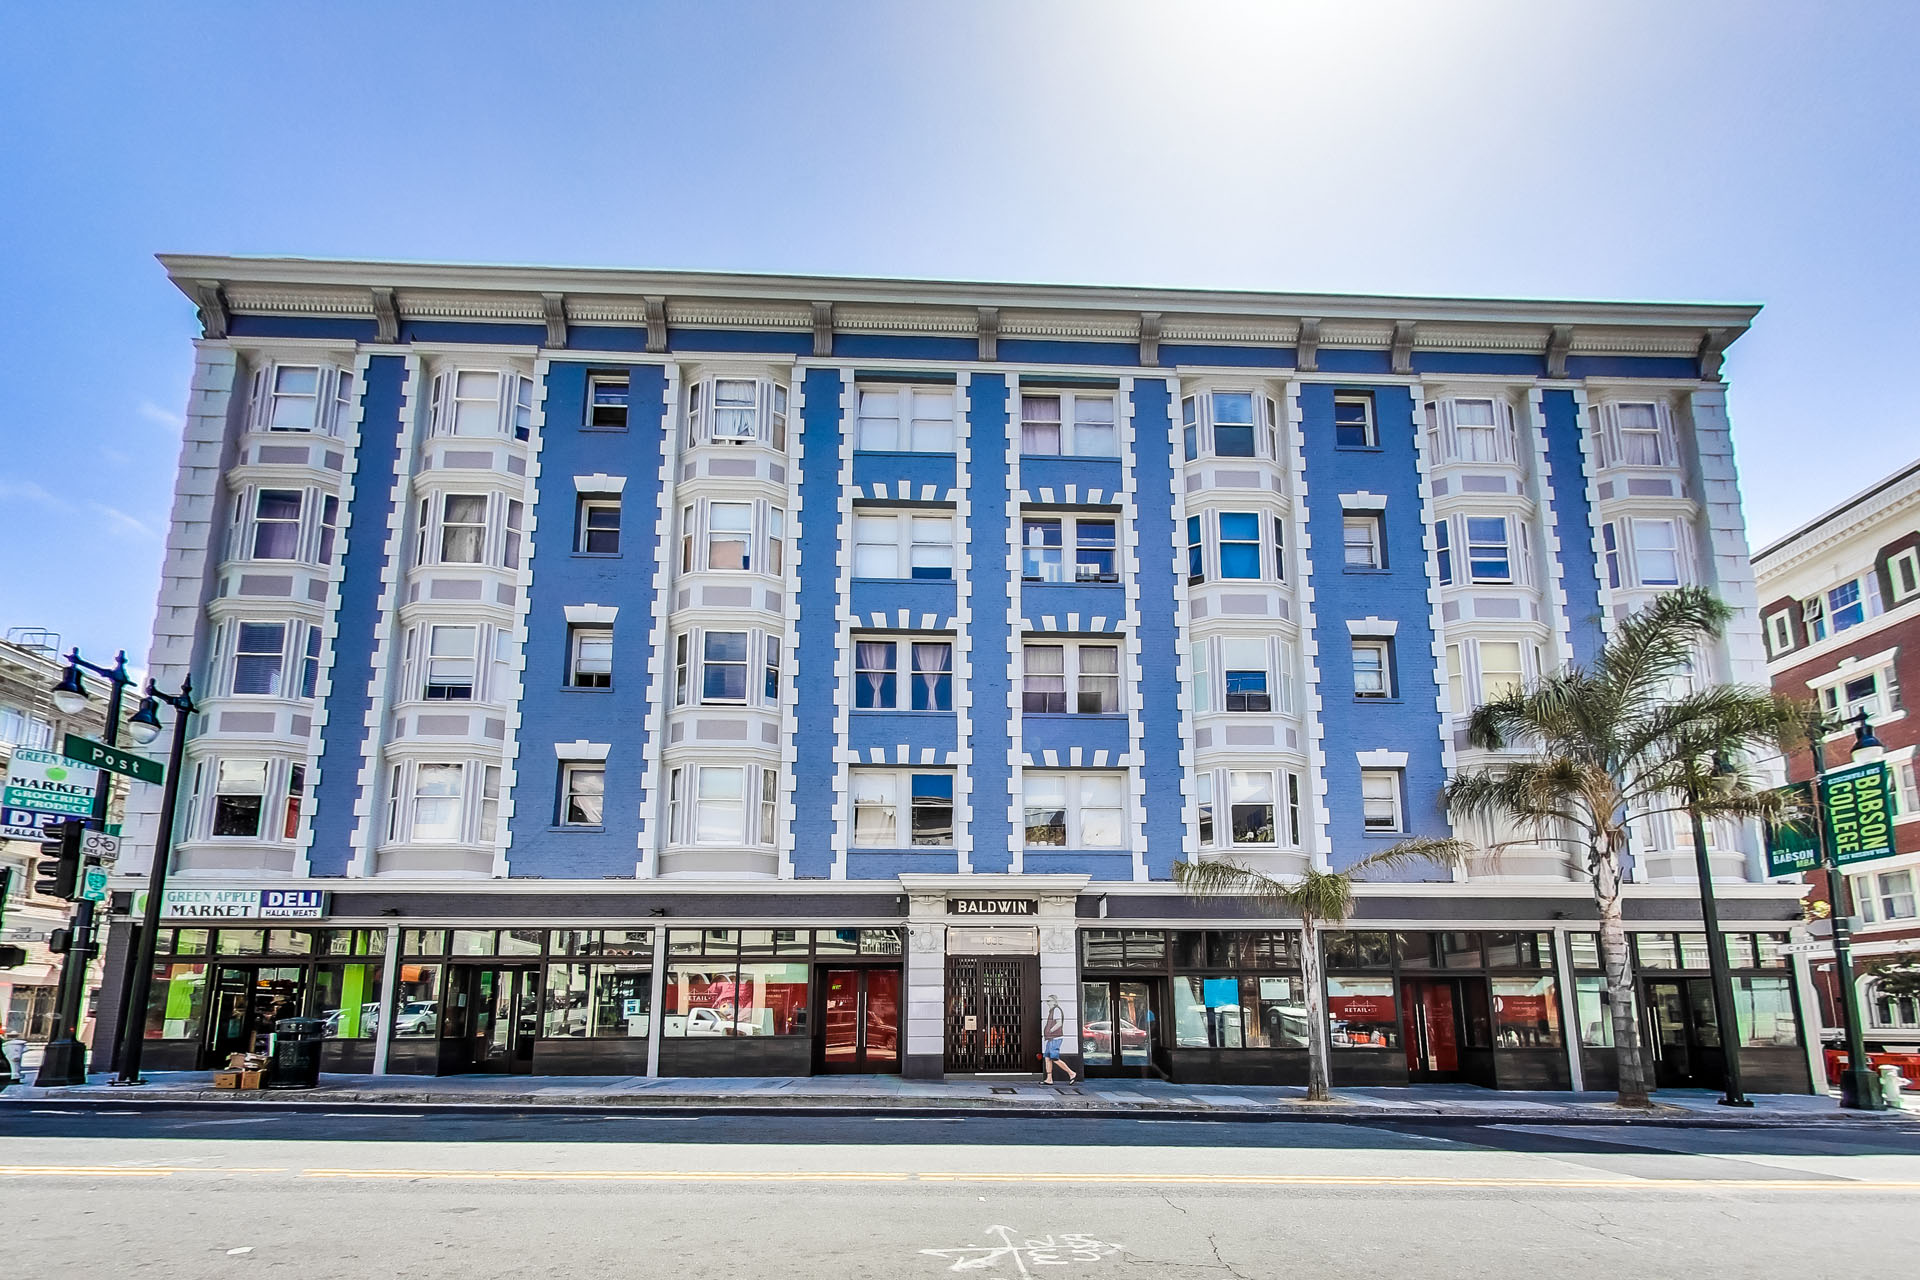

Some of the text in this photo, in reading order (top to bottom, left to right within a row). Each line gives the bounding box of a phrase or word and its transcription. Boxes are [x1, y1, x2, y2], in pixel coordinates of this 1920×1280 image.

[15, 750, 58, 765] GREEN
[91, 747, 140, 773] Post
[11, 777, 95, 796] MARKET
[11, 789, 90, 805] GROCERIES
[9, 797, 89, 814] & PRODUCE
[1855, 774, 1888, 850] BABSON
[1828, 782, 1859, 854] COLLEGE
[3, 827, 44, 838] HALAL
[1773, 849, 1814, 865] BABSON
[1796, 858, 1816, 868] MBA
[167, 891, 257, 903] GREEN APPLE
[268, 892, 318, 907] DELI
[171, 905, 252, 917] MARKET
[265, 909, 318, 917] HALAL MEATS
[957, 900, 1028, 914] BALDWIN
